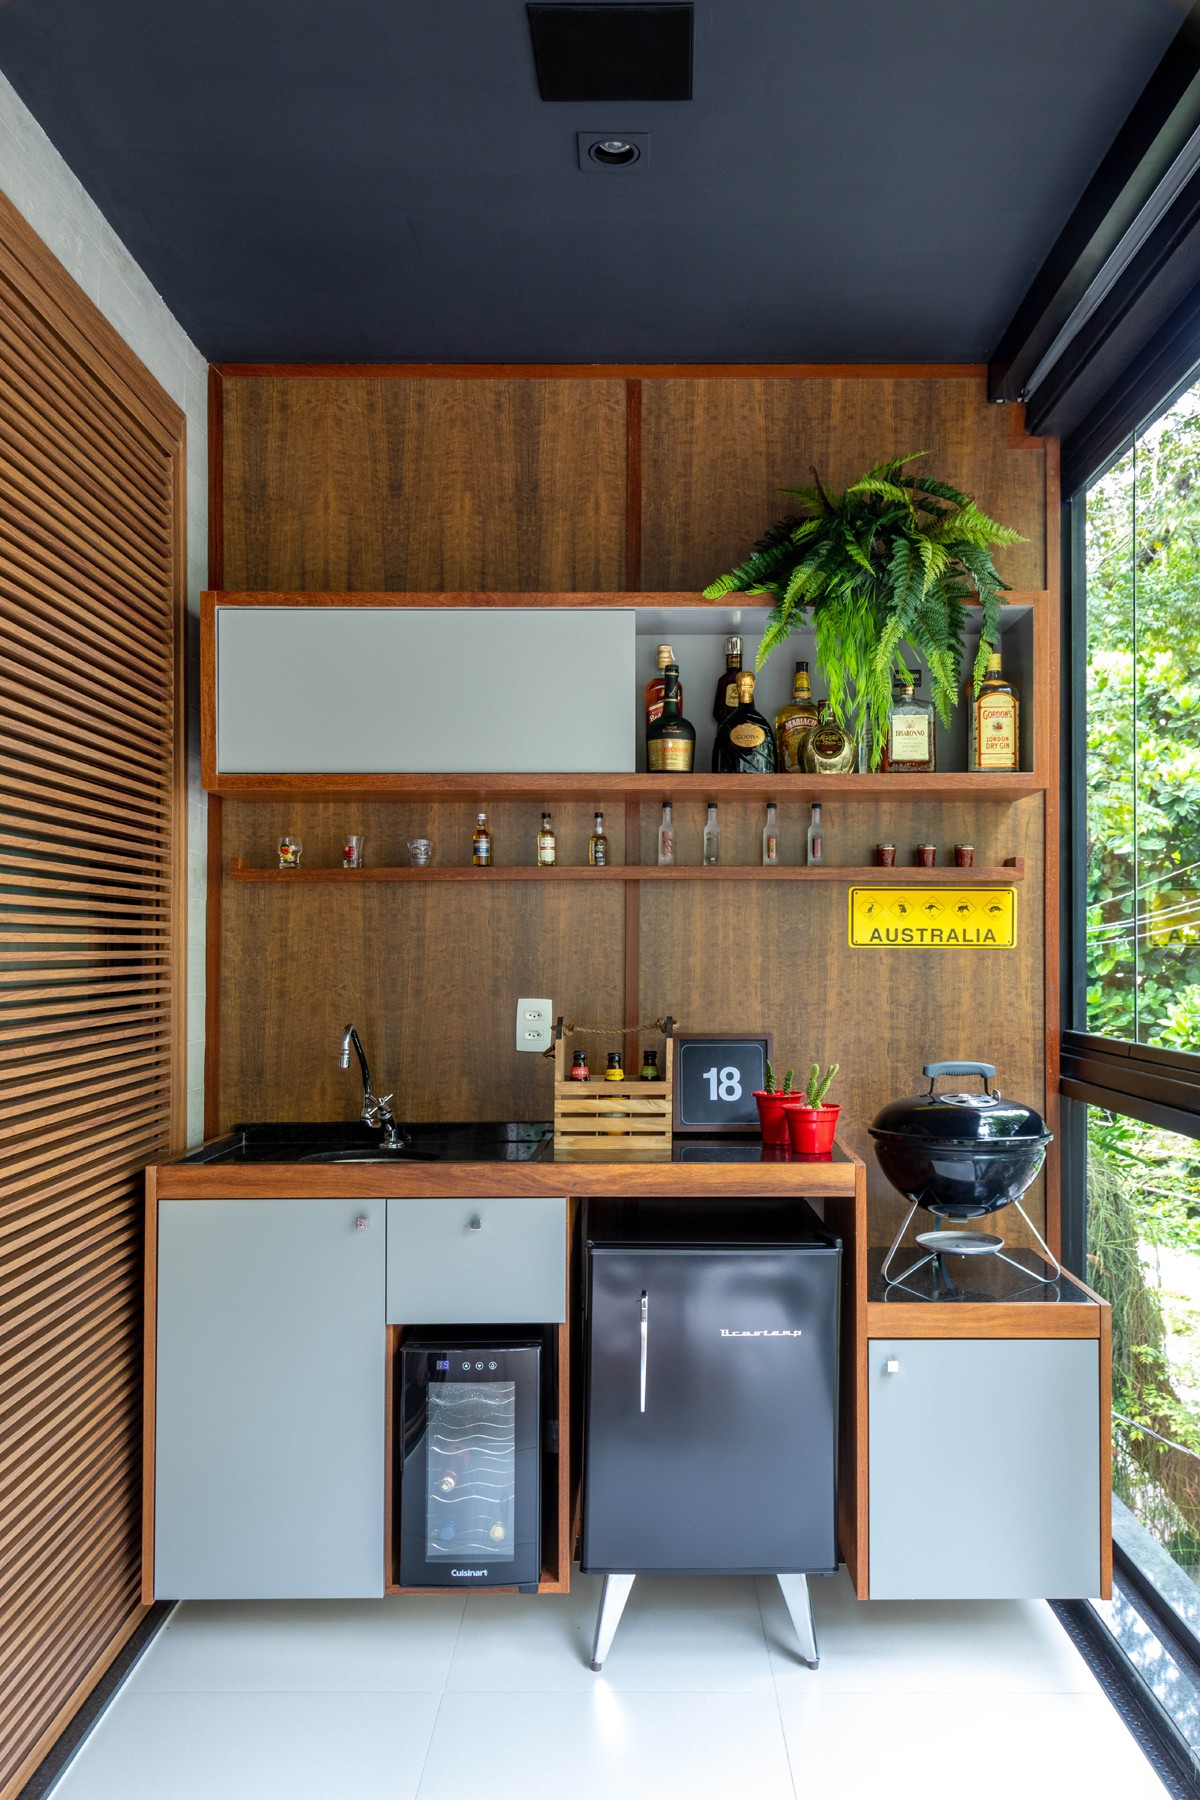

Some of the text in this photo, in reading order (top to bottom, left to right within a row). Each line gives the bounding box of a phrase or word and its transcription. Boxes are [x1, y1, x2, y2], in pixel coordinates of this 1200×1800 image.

[869, 928, 997, 942] AUSTRALIA
[703, 1066, 742, 1101] 18
[720, 1329, 801, 1337] Brastemp
